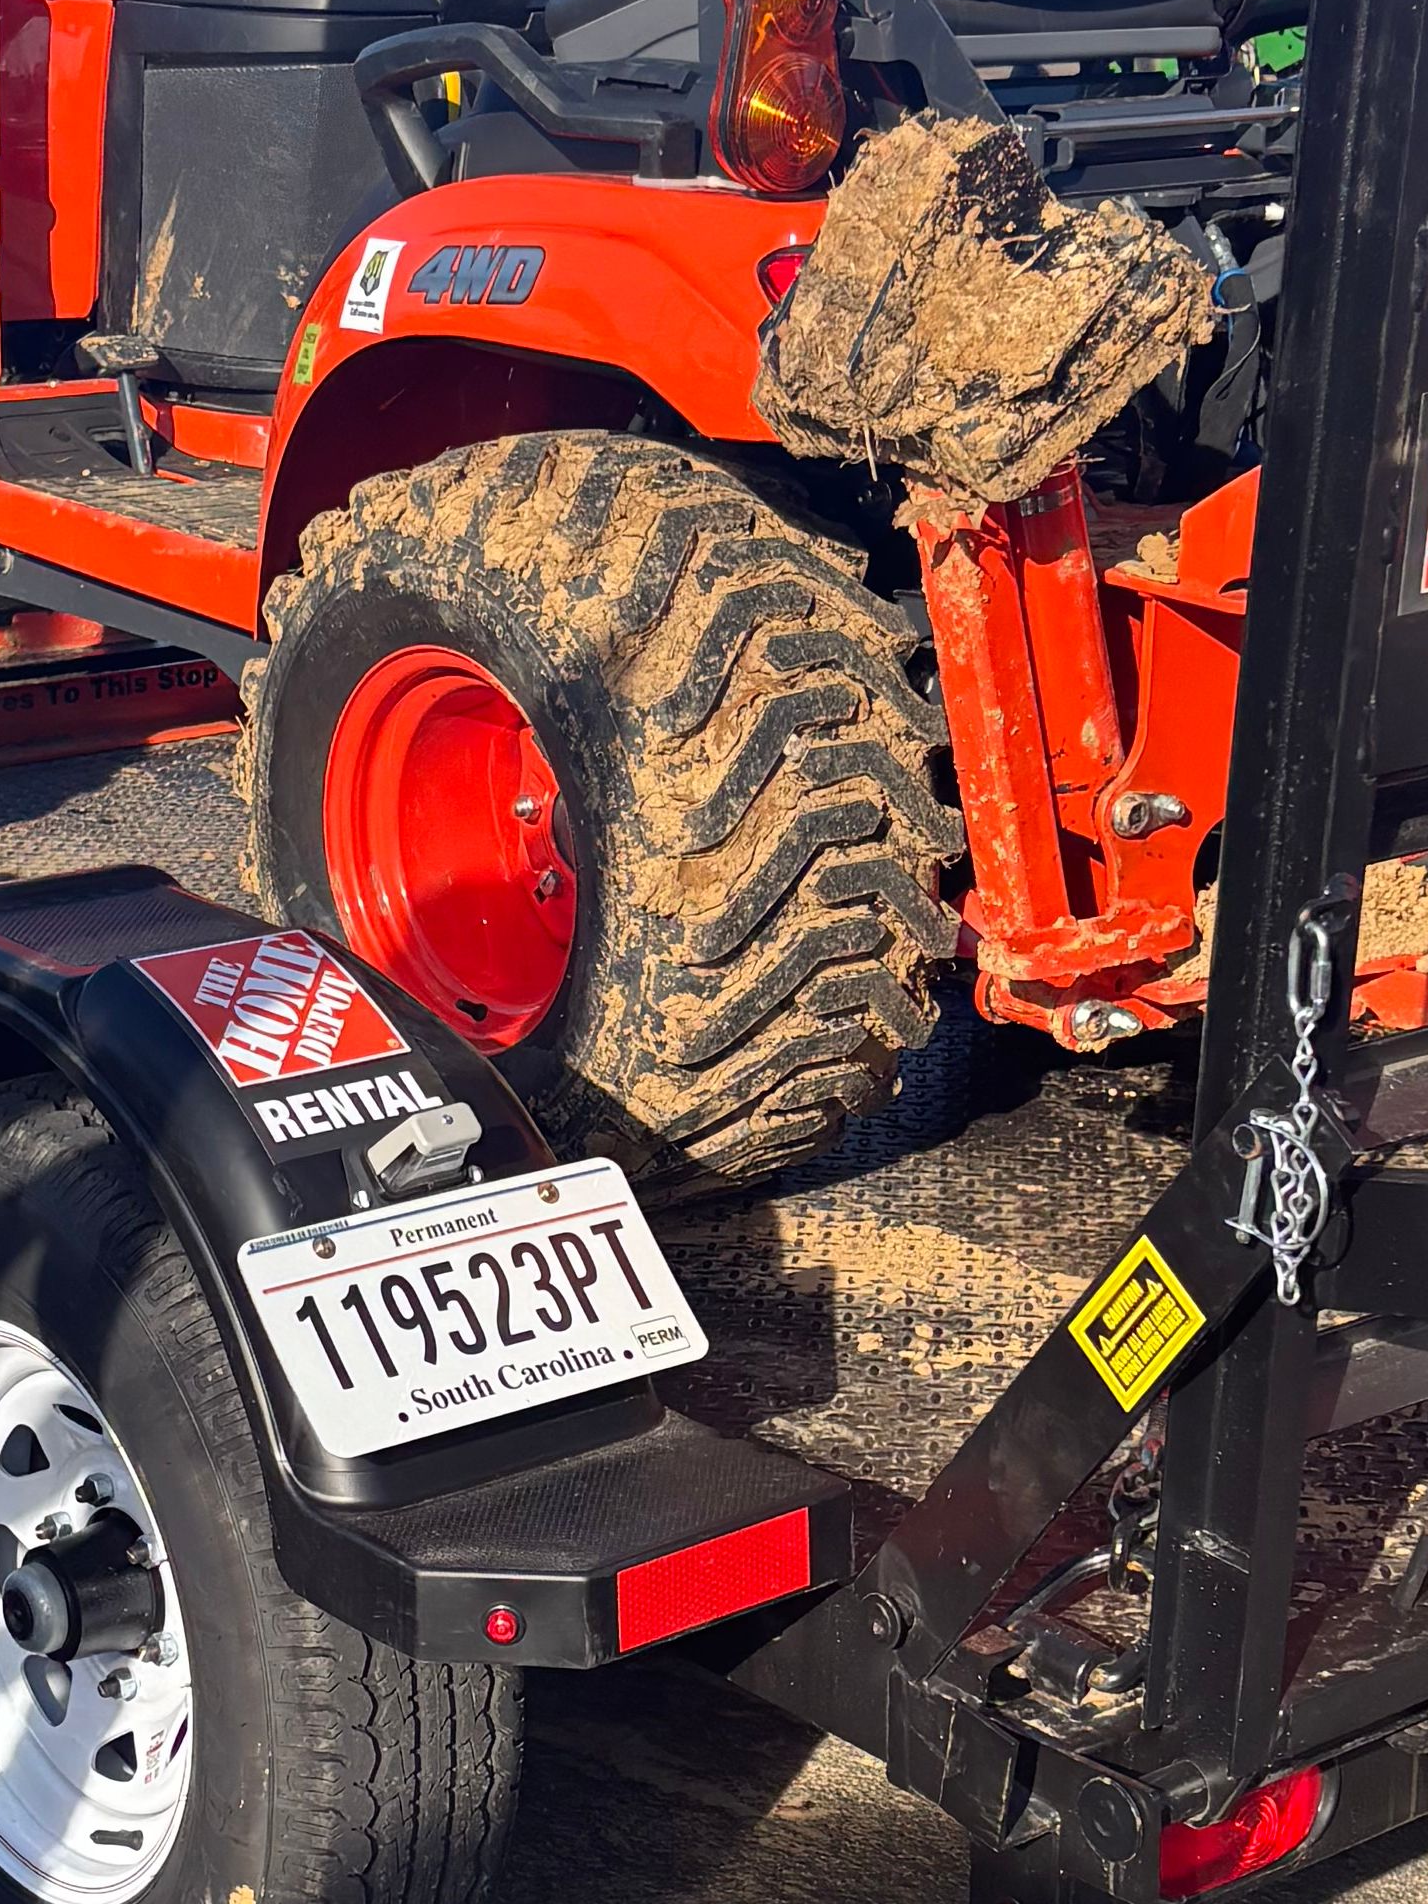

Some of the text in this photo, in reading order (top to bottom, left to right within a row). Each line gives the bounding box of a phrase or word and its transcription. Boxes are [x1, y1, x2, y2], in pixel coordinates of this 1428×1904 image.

[408, 246, 546, 305] 4WD
[44, 684, 81, 705] To
[90, 674, 147, 700] This
[157, 664, 218, 690] Stop
[193, 957, 245, 1009] THE
[218, 936, 324, 1077] HOME
[294, 970, 358, 1067] DEPOT
[254, 1071, 444, 1143] RENTAL
[390, 1207, 499, 1248] Permanent
[296, 1219, 653, 1391] 119523PT
[1101, 1277, 1144, 1332] CAUTION
[637, 1327, 685, 1350] PERM
[410, 1344, 616, 1416] South Carolina
